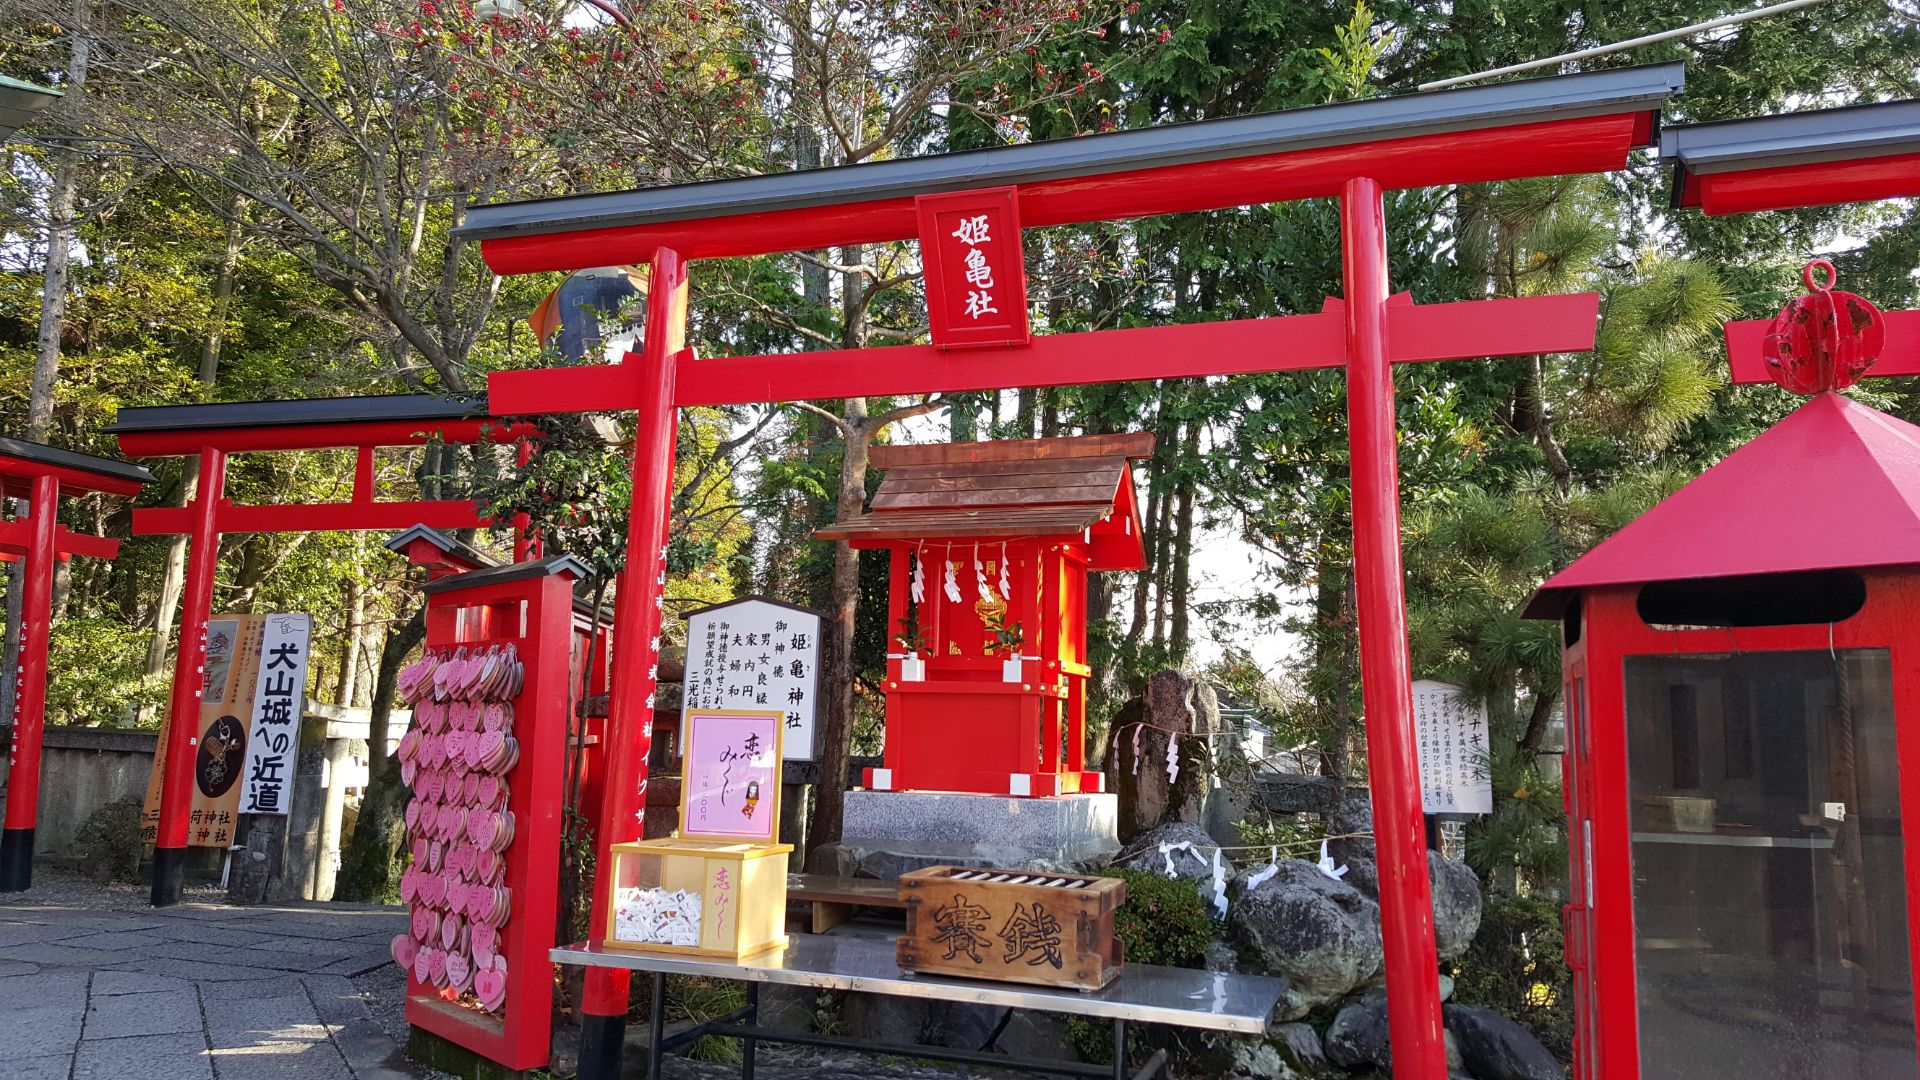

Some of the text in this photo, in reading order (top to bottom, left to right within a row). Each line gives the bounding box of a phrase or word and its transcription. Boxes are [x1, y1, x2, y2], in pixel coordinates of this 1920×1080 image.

[952, 215, 997, 319] 姫亀社
[19, 621, 28, 652] 犬山市
[200, 621, 208, 652] 犬山市
[714, 621, 730, 709] 御神徳授与せられ
[756, 633, 771, 705] 男女良縁
[773, 620, 787, 678] 御神徳
[806, 634, 812, 649] ひめ
[786, 633, 806, 729] 姫亀神社
[247, 643, 300, 812] 犬山城への近道
[635, 636, 660, 842] 株式会社イクサ
[713, 867, 731, 941] 恋みくじ
[929, 893, 1063, 969] 賽銭
